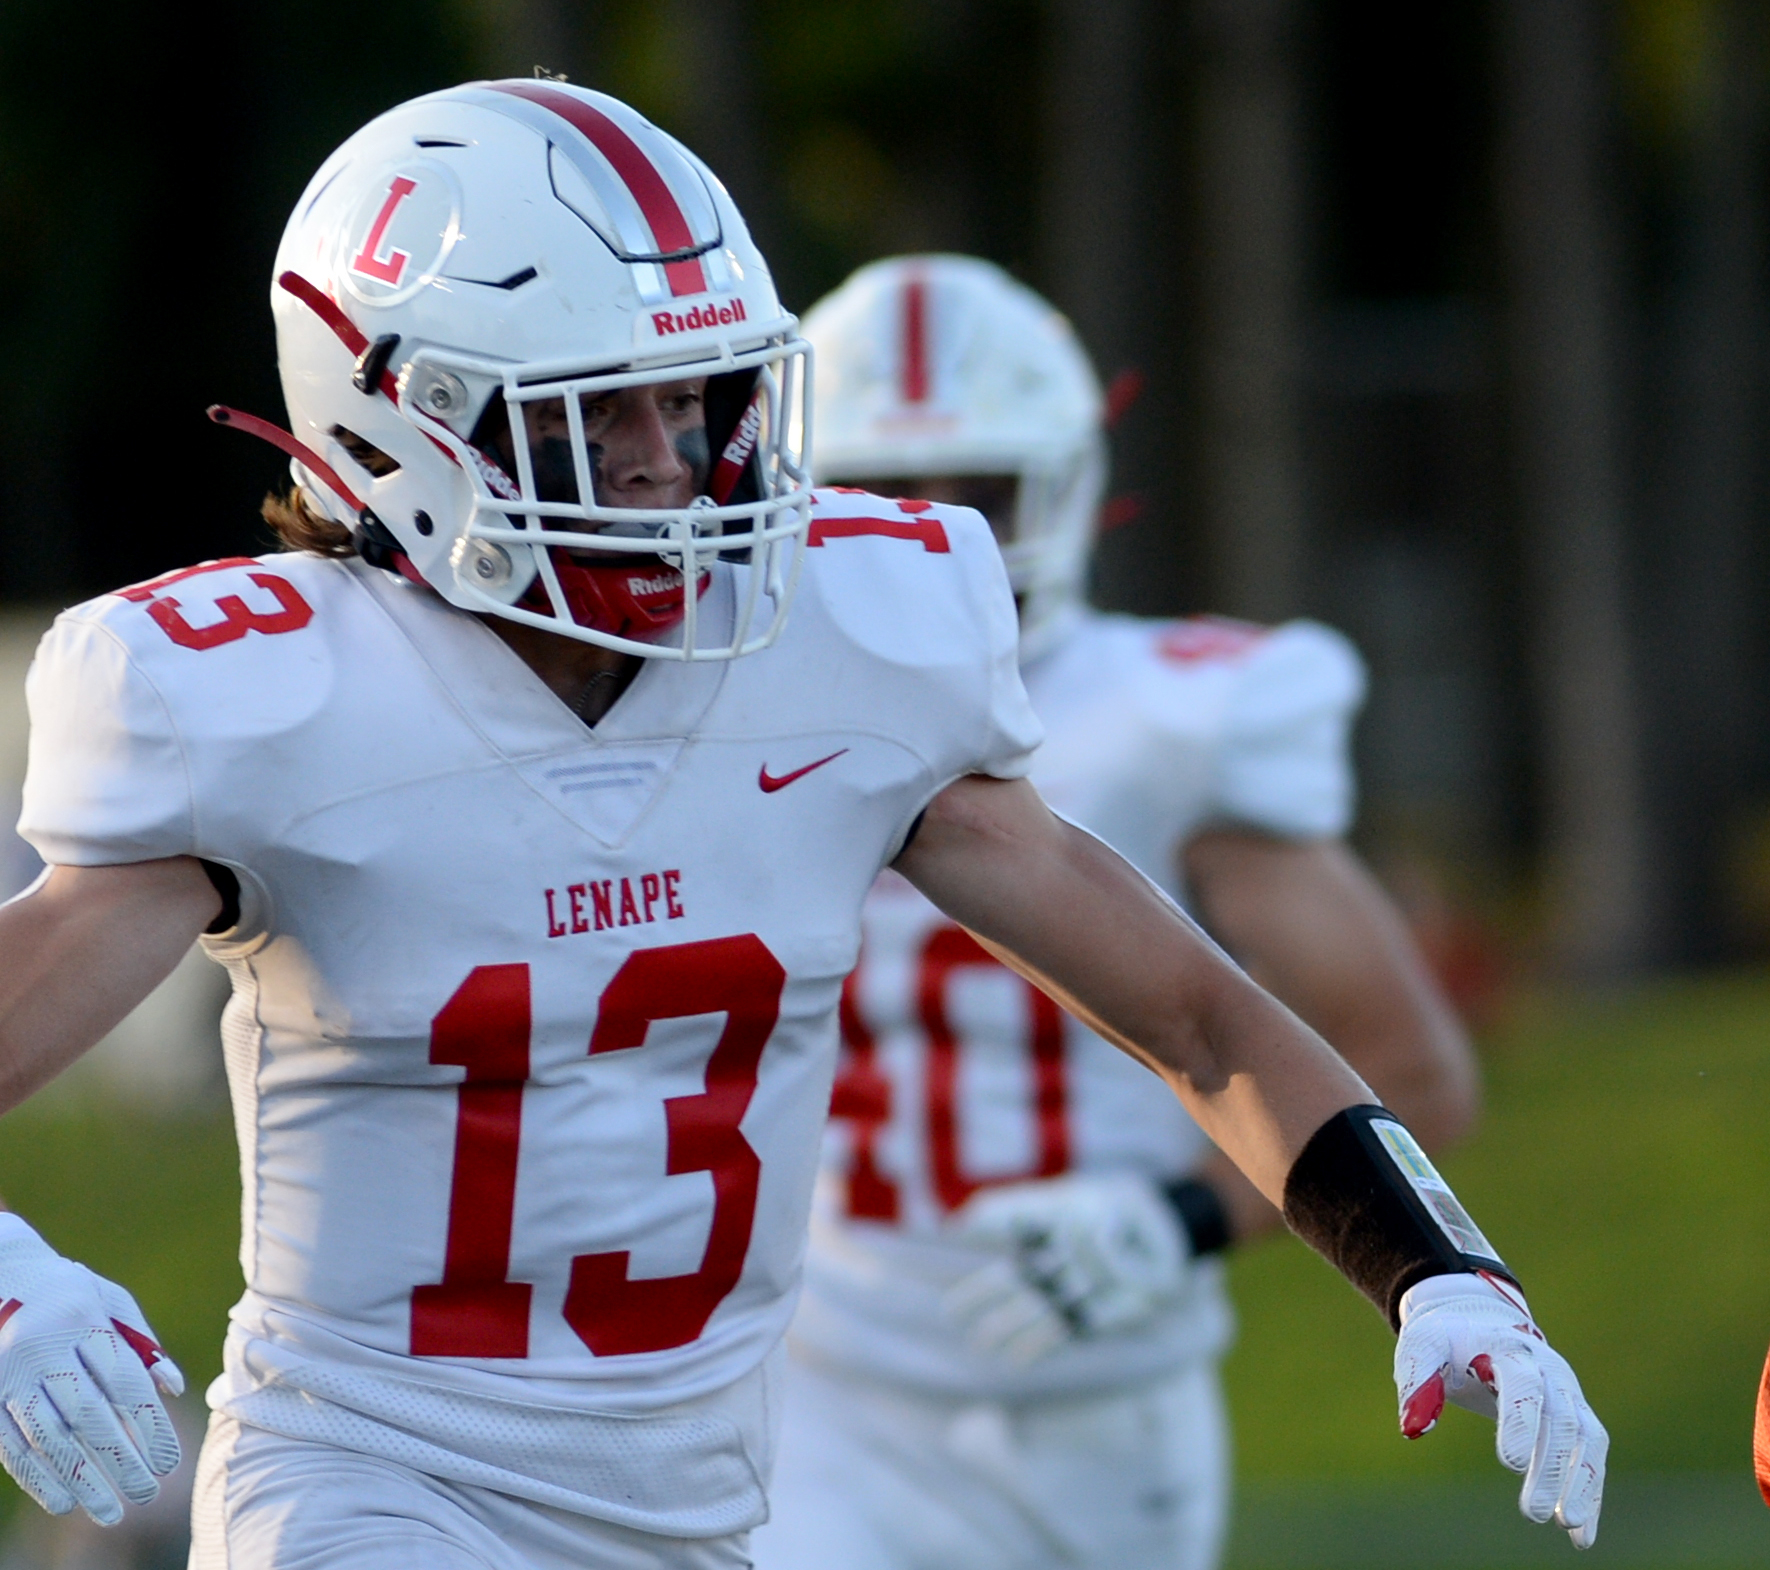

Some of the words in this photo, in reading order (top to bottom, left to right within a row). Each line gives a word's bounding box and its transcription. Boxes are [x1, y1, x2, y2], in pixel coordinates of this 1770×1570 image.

[351, 175, 419, 286] L
[650, 298, 747, 336] Riddell
[722, 397, 761, 467] Ridd
[465, 445, 521, 501] Ridde
[108, 556, 315, 652] 13
[627, 572, 684, 596] Ridde
[544, 869, 684, 938] LENAPE
[410, 932, 787, 1359] 13
